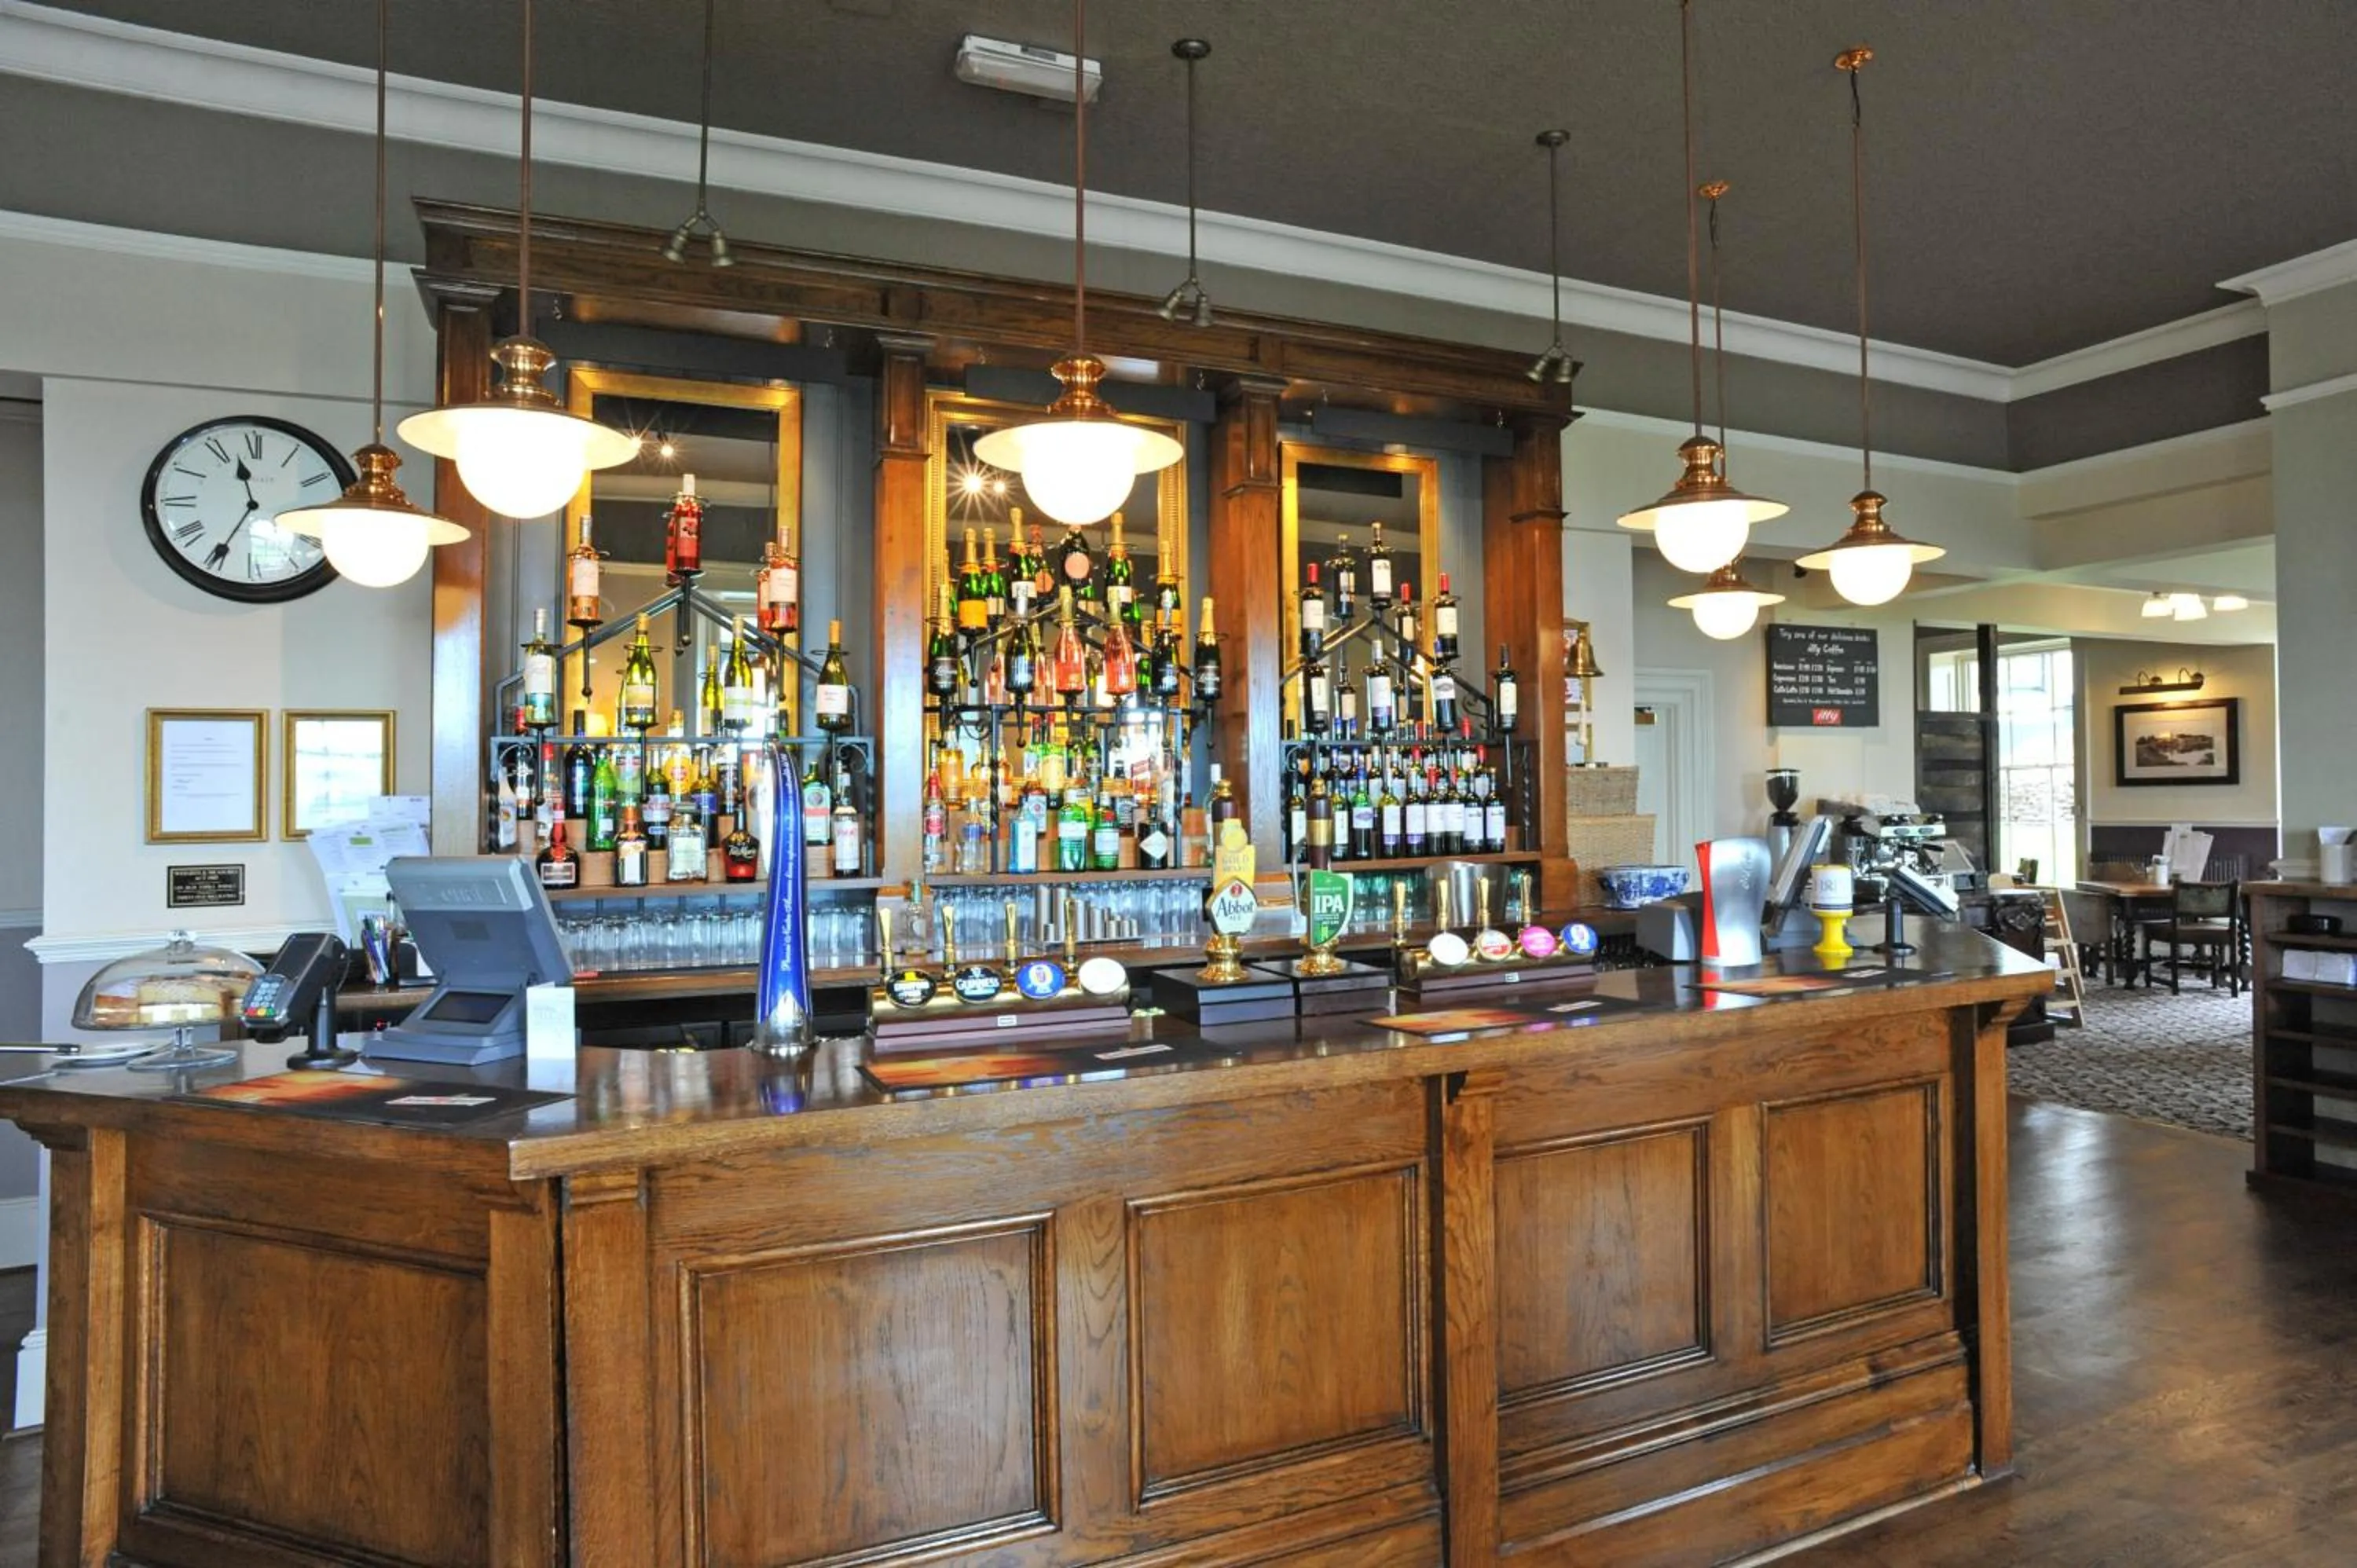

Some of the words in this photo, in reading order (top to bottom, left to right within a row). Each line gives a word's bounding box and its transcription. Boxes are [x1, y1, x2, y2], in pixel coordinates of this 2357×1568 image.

[1216, 897, 1254, 918] Abbot
[1314, 895, 1345, 914] IPA
[955, 977, 1000, 991] GUINNESS
